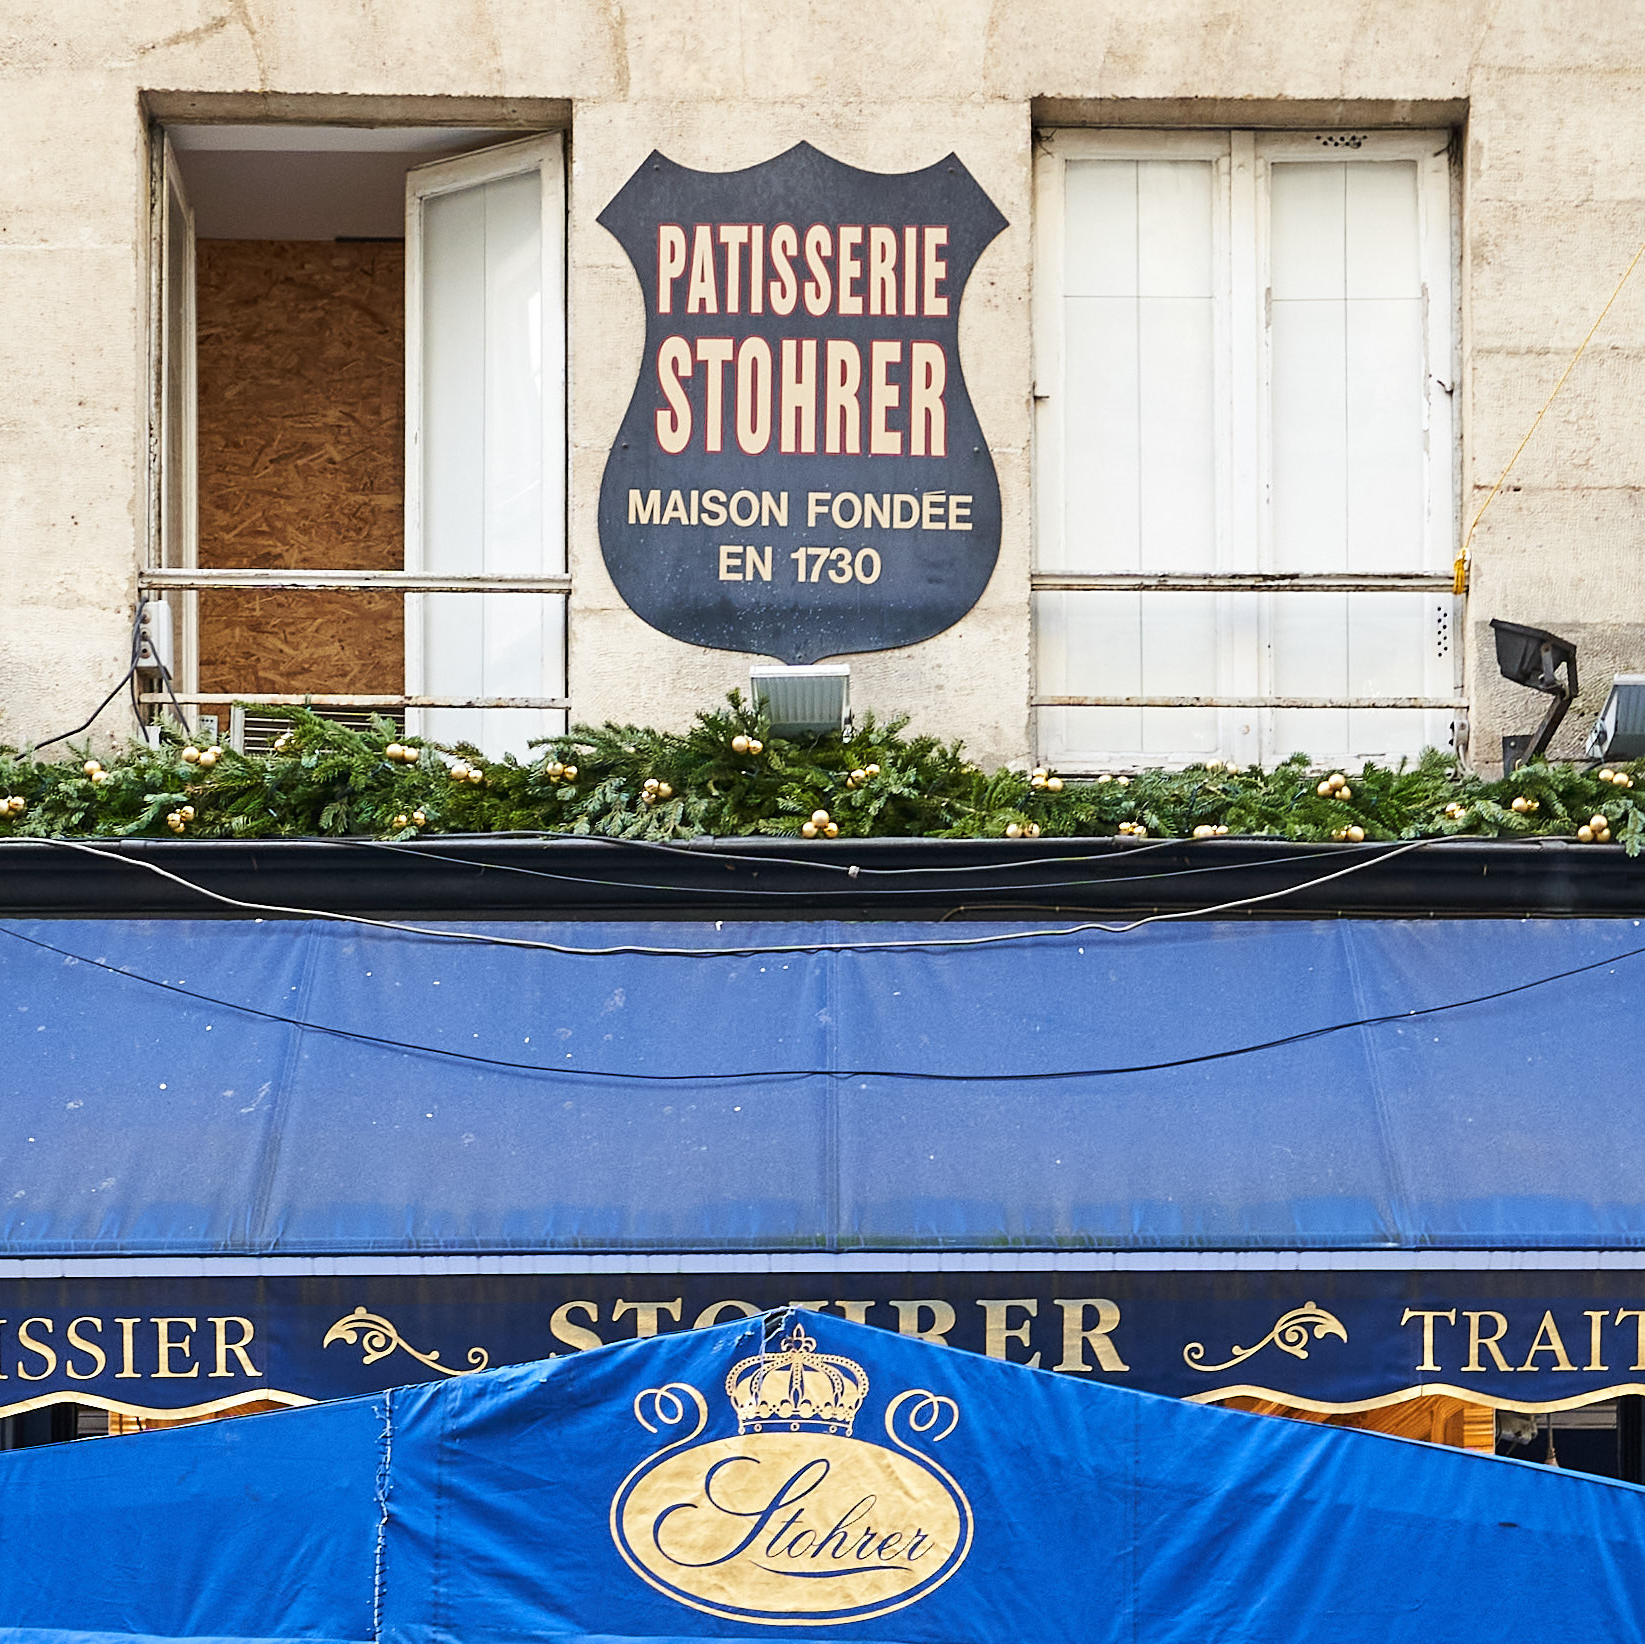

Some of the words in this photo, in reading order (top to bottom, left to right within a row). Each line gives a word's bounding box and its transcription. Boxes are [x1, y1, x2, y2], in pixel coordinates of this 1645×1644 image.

[657, 223, 950, 318] PATISSERIE
[656, 335, 948, 457] STOHRER
[628, 489, 789, 528] MAISON
[808, 490, 973, 531] FONDÉE
[719, 545, 773, 582] EN
[790, 547, 882, 585] 1730
[652, 1456, 934, 1574] Stohrer
